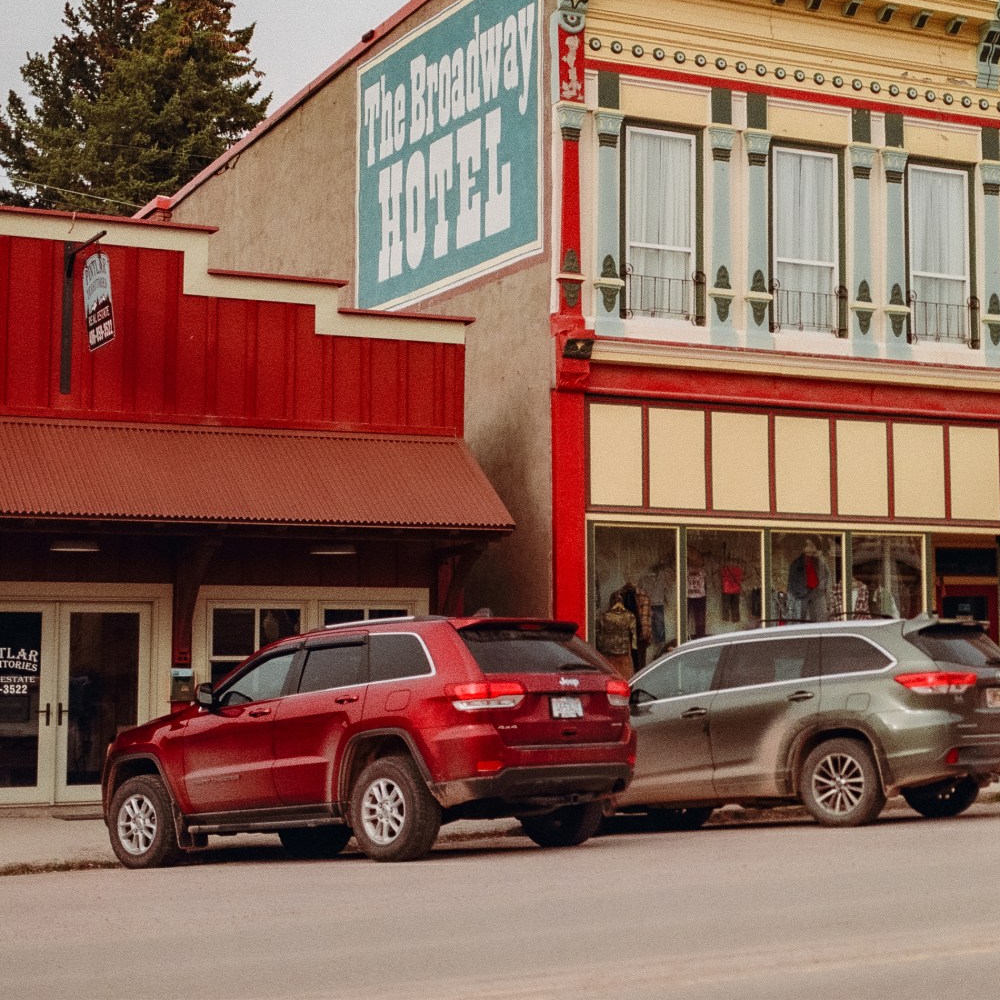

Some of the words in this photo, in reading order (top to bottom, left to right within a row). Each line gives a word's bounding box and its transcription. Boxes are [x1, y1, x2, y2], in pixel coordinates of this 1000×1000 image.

[364, 74, 406, 168] The
[409, 2, 536, 145] Broadway
[377, 106, 511, 283] HOTEL
[0, 675, 36, 683] ESTATE
[559, 676, 580, 688] Jeep
